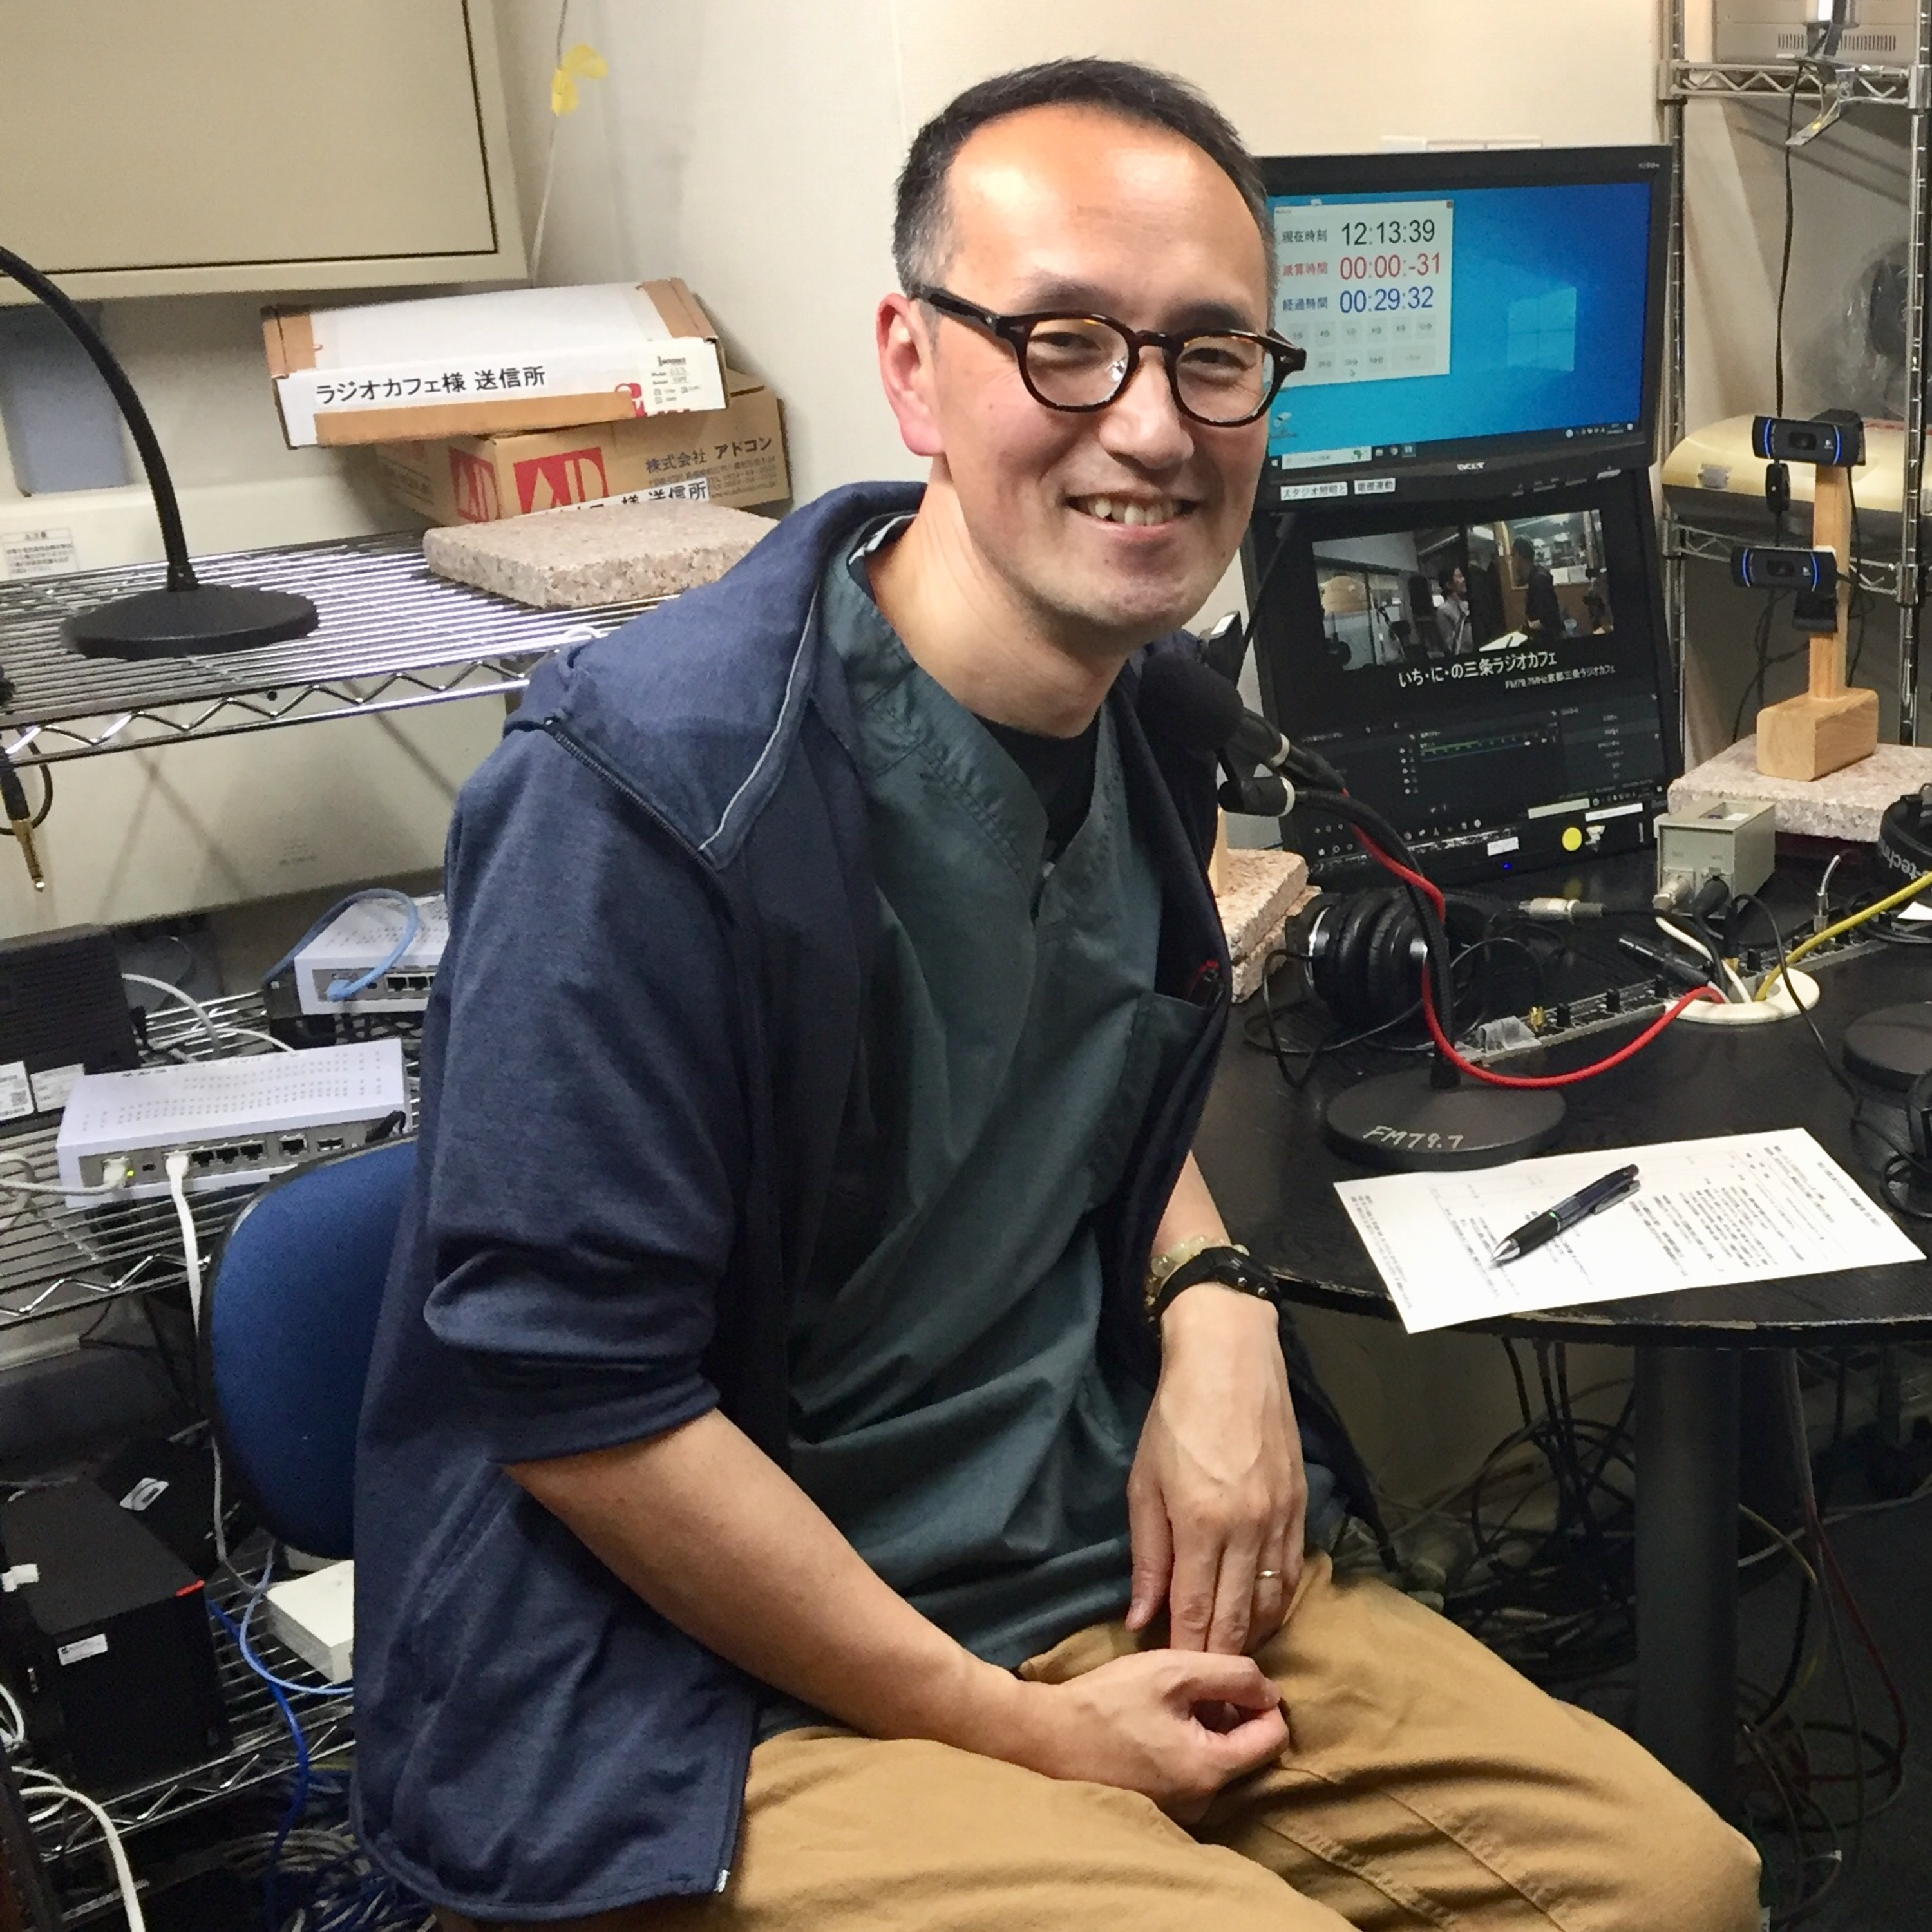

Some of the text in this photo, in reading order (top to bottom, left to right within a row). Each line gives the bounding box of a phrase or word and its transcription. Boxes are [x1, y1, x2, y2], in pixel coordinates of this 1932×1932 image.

[1341, 219, 1435, 246] 12:13:39
[1340, 252, 1440, 280] 00:00:-31
[1340, 286, 1434, 313] 00:29:32
[316, 366, 545, 404] ラジオカフェ様 送信所
[646, 448, 707, 473] 株式会社
[1363, 1125, 1464, 1149] FM79.7
